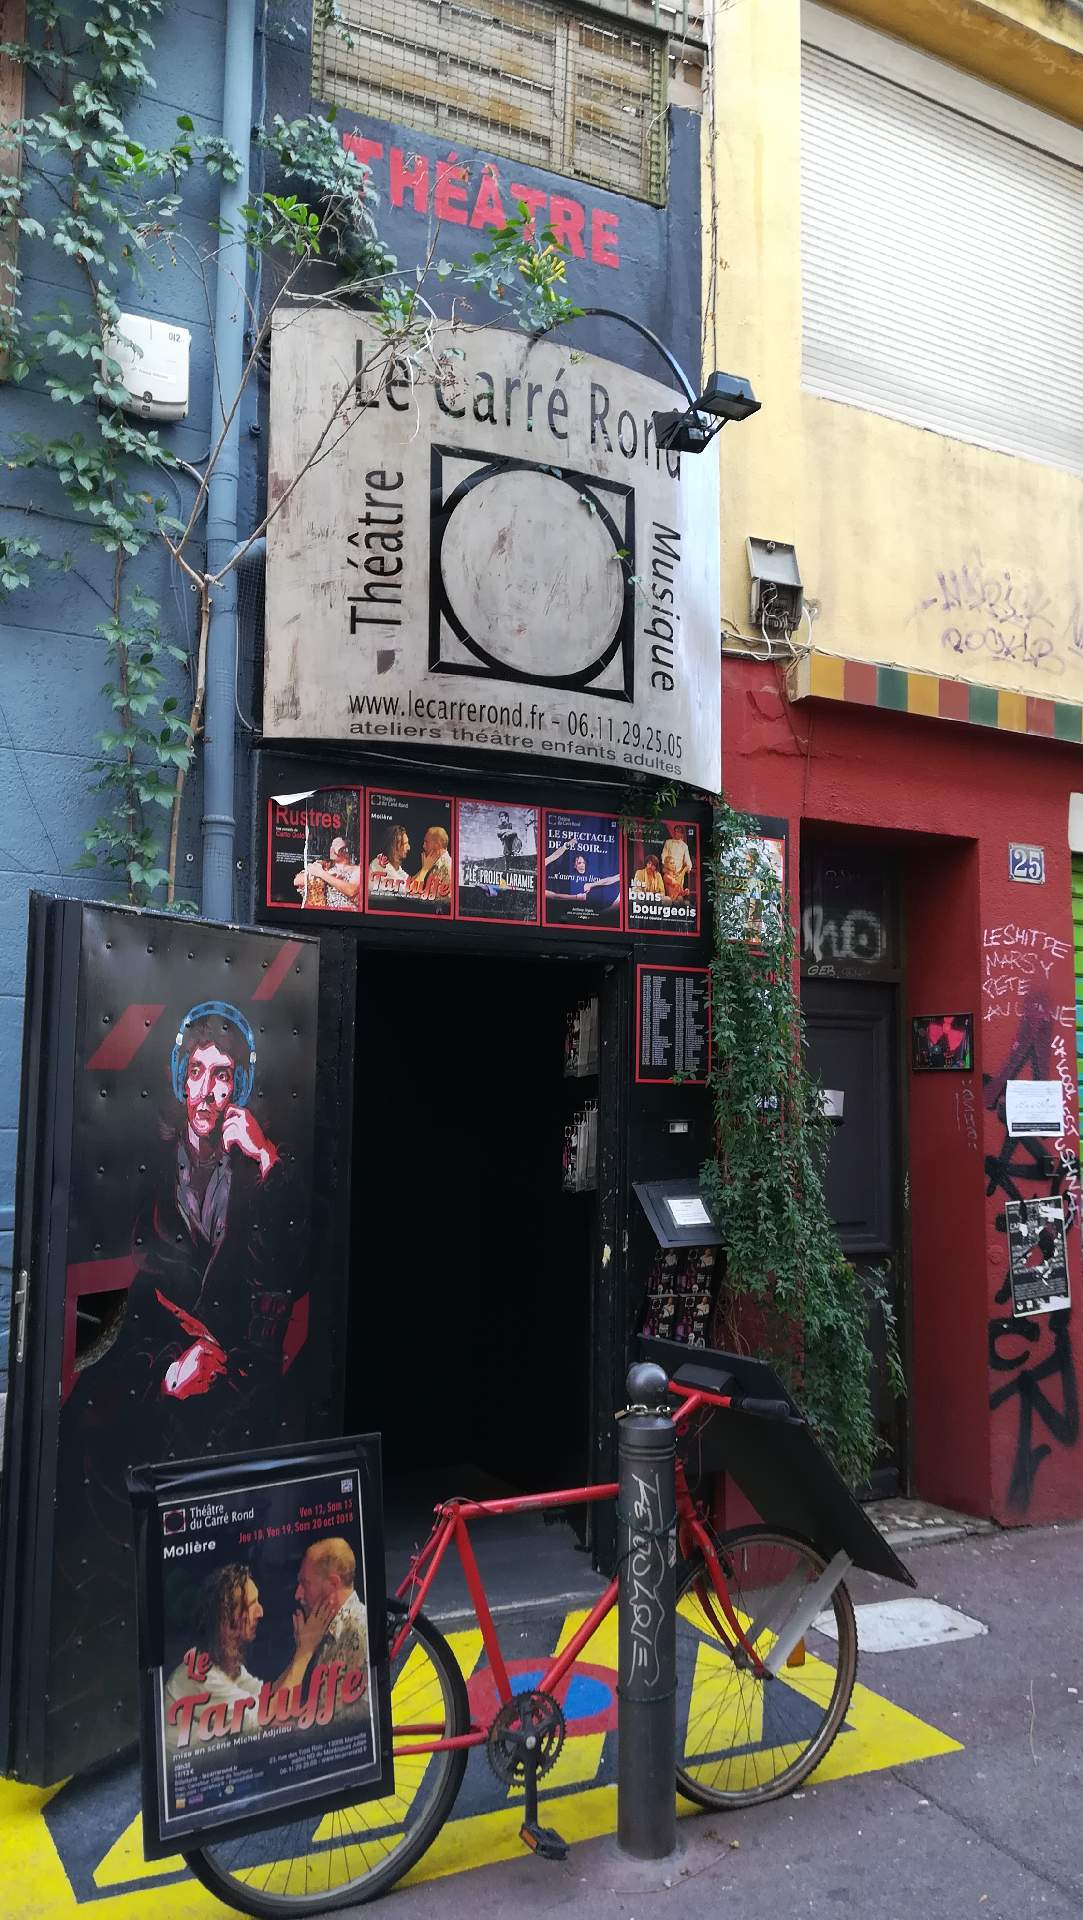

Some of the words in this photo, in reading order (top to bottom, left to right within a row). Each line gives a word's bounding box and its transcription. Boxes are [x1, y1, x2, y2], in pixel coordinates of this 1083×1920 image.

[342, 133, 621, 270] THÉÂTRE
[356, 339, 409, 411] Le
[434, 347, 568, 439] Carré
[347, 470, 404, 635] Théâtre
[644, 521, 681, 691] Musique
[349, 690, 544, 731] www.lecarrerond.fr
[568, 711, 682, 759] 06.11.29.25.05
[350, 722, 441, 738] ateliers
[453, 729, 534, 748] théâtre
[541, 740, 616, 760] enfants
[624, 752, 682, 775] adultes
[276, 805, 341, 829] Rustres
[548, 829, 560, 839] LE
[562, 830, 615, 843] SPECTACLE
[1013, 849, 1041, 878] 25
[371, 871, 450, 900] Tartuffe
[469, 868, 477, 881] LE
[480, 870, 503, 885] PROJET
[506, 872, 534, 889] LARAMIE
[629, 887, 662, 902] bons
[632, 901, 697, 918] bourgeois
[190, 1503, 224, 1519] Théâtre
[190, 1518, 202, 1531] du
[205, 1512, 229, 1528] Carré
[231, 1508, 254, 1524] Rond
[312, 1518, 322, 1529] 20
[323, 1516, 335, 1527] oct
[163, 1539, 216, 1559] Molière
[183, 1646, 212, 1682] Le
[167, 1661, 366, 1748] Tartuffe
[233, 1733, 260, 1746] Michel
